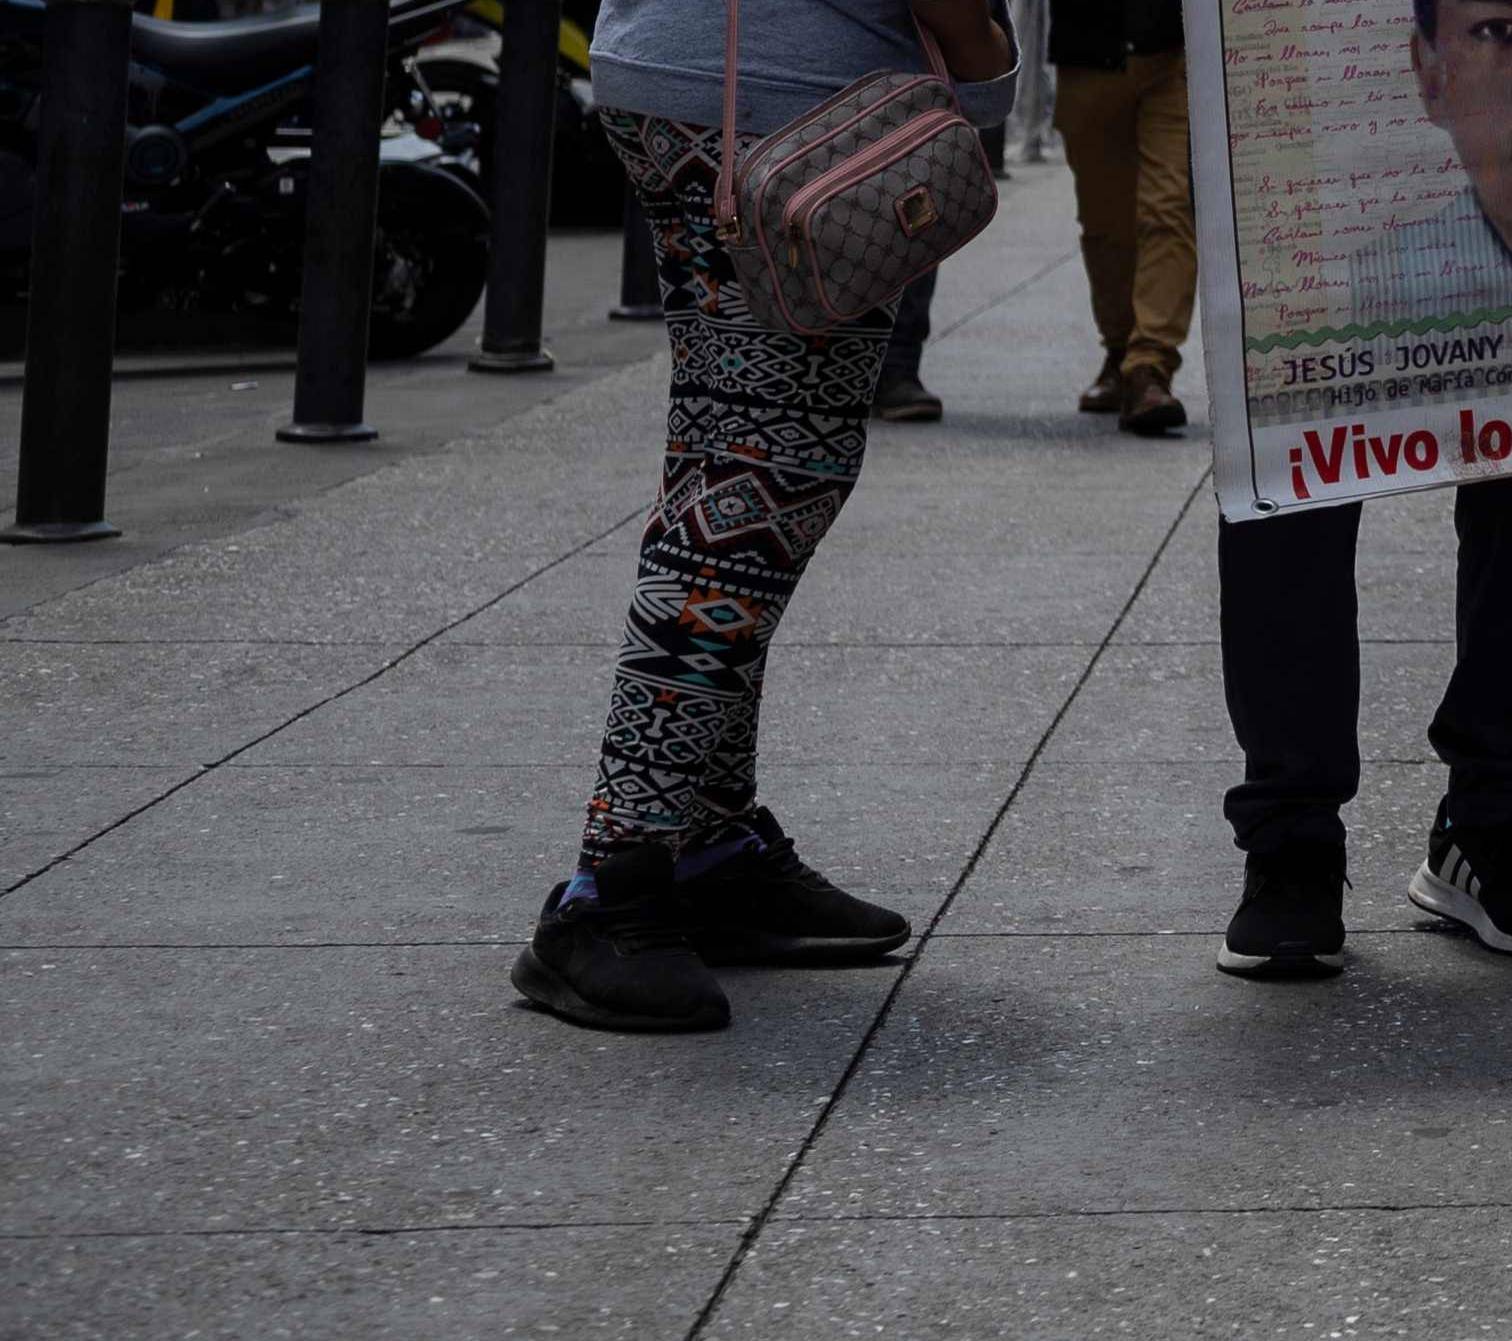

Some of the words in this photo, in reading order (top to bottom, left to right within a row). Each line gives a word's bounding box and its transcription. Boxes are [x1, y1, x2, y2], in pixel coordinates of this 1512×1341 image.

[1283, 346, 1375, 386] JESÚS
[1396, 334, 1504, 371] JOVANY
[1331, 385, 1377, 409] Hijo
[1386, 379, 1409, 399] de
[1419, 371, 1475, 395] María
[1288, 423, 1438, 500] ¡Vivo
[1459, 409, 1512, 464] lo
